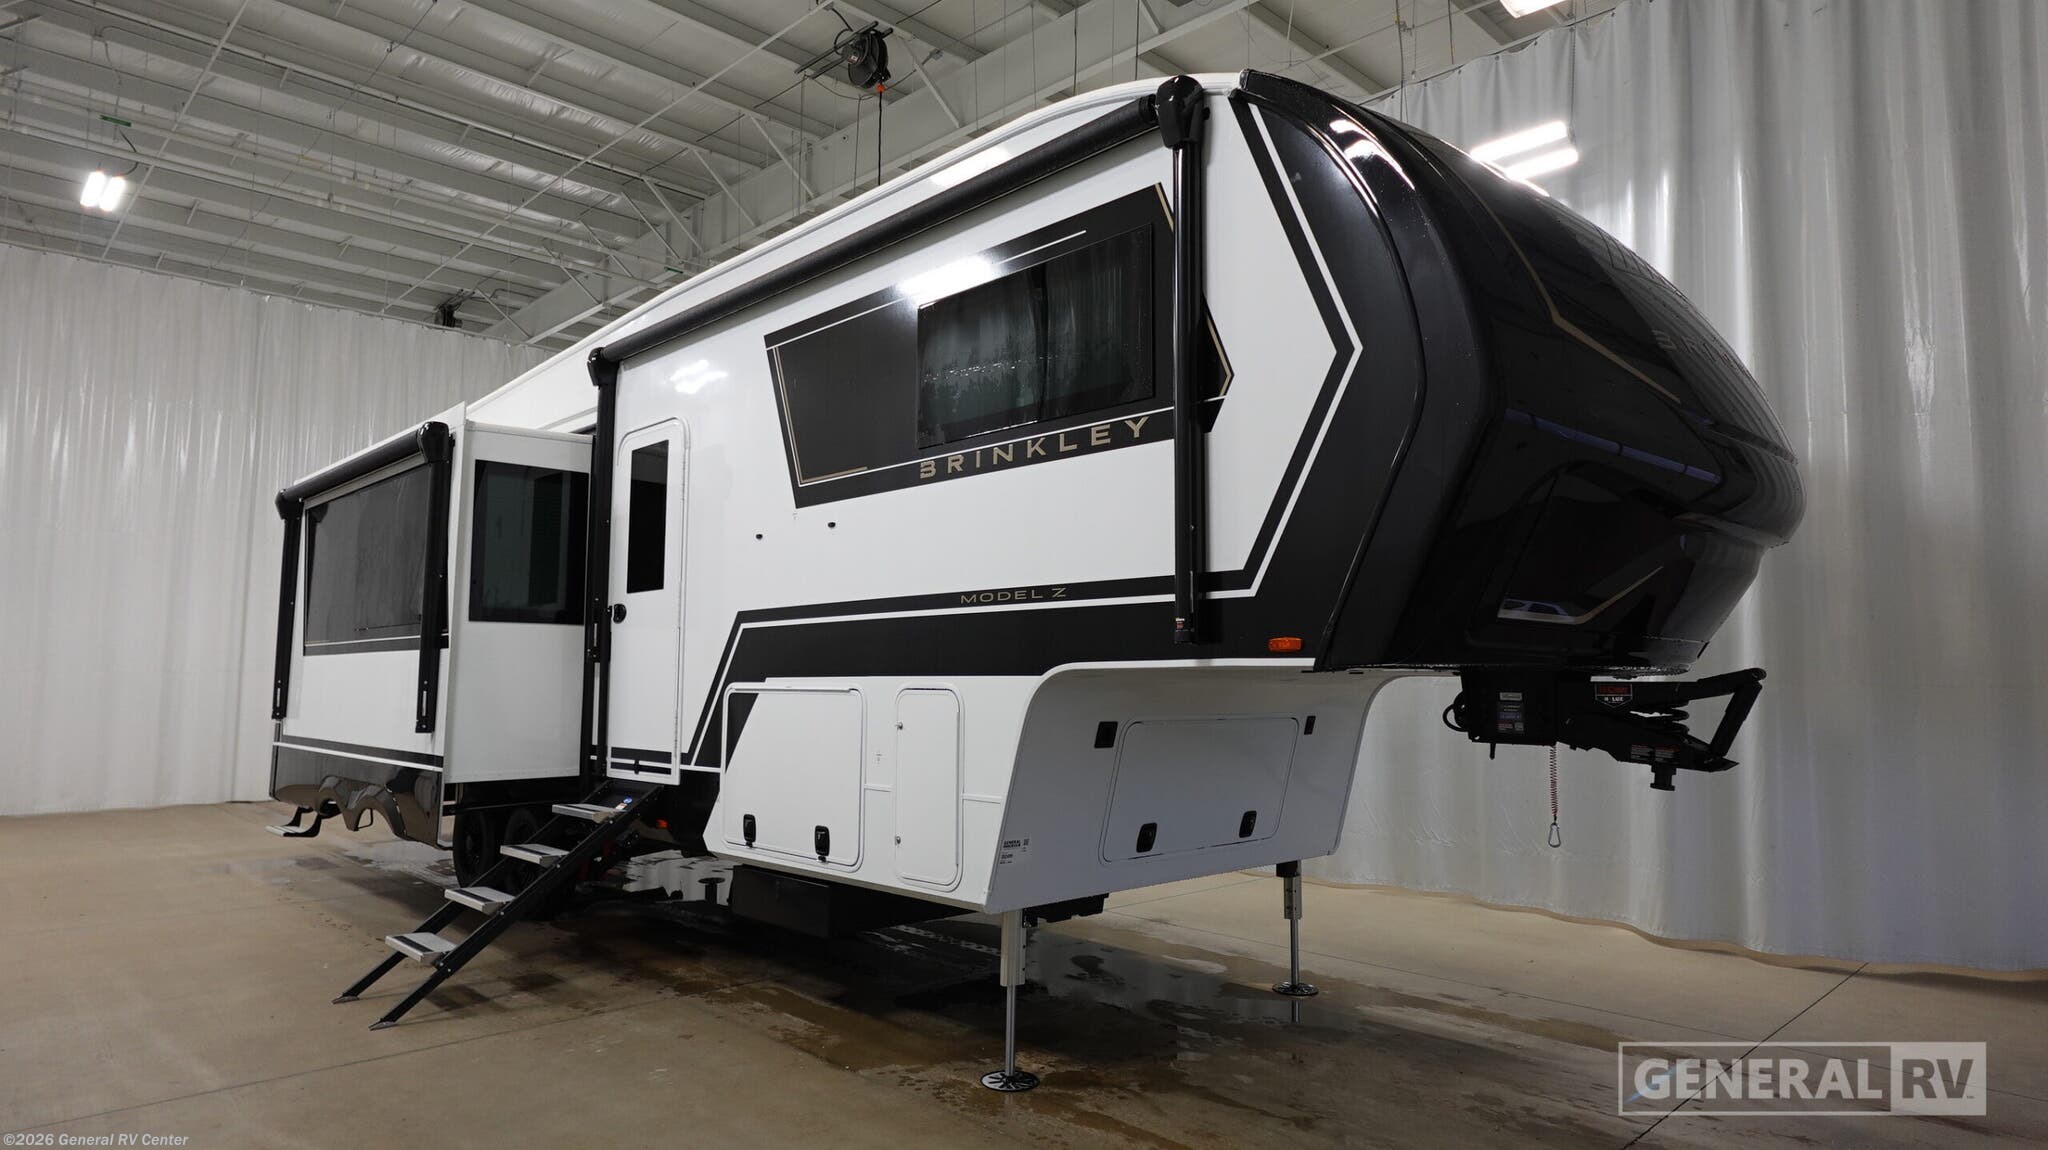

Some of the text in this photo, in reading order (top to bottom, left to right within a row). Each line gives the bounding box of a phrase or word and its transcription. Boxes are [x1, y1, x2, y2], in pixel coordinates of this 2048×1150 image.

[919, 416, 1149, 479] BRINKLEY
[960, 587, 1067, 604] MODEL Z
